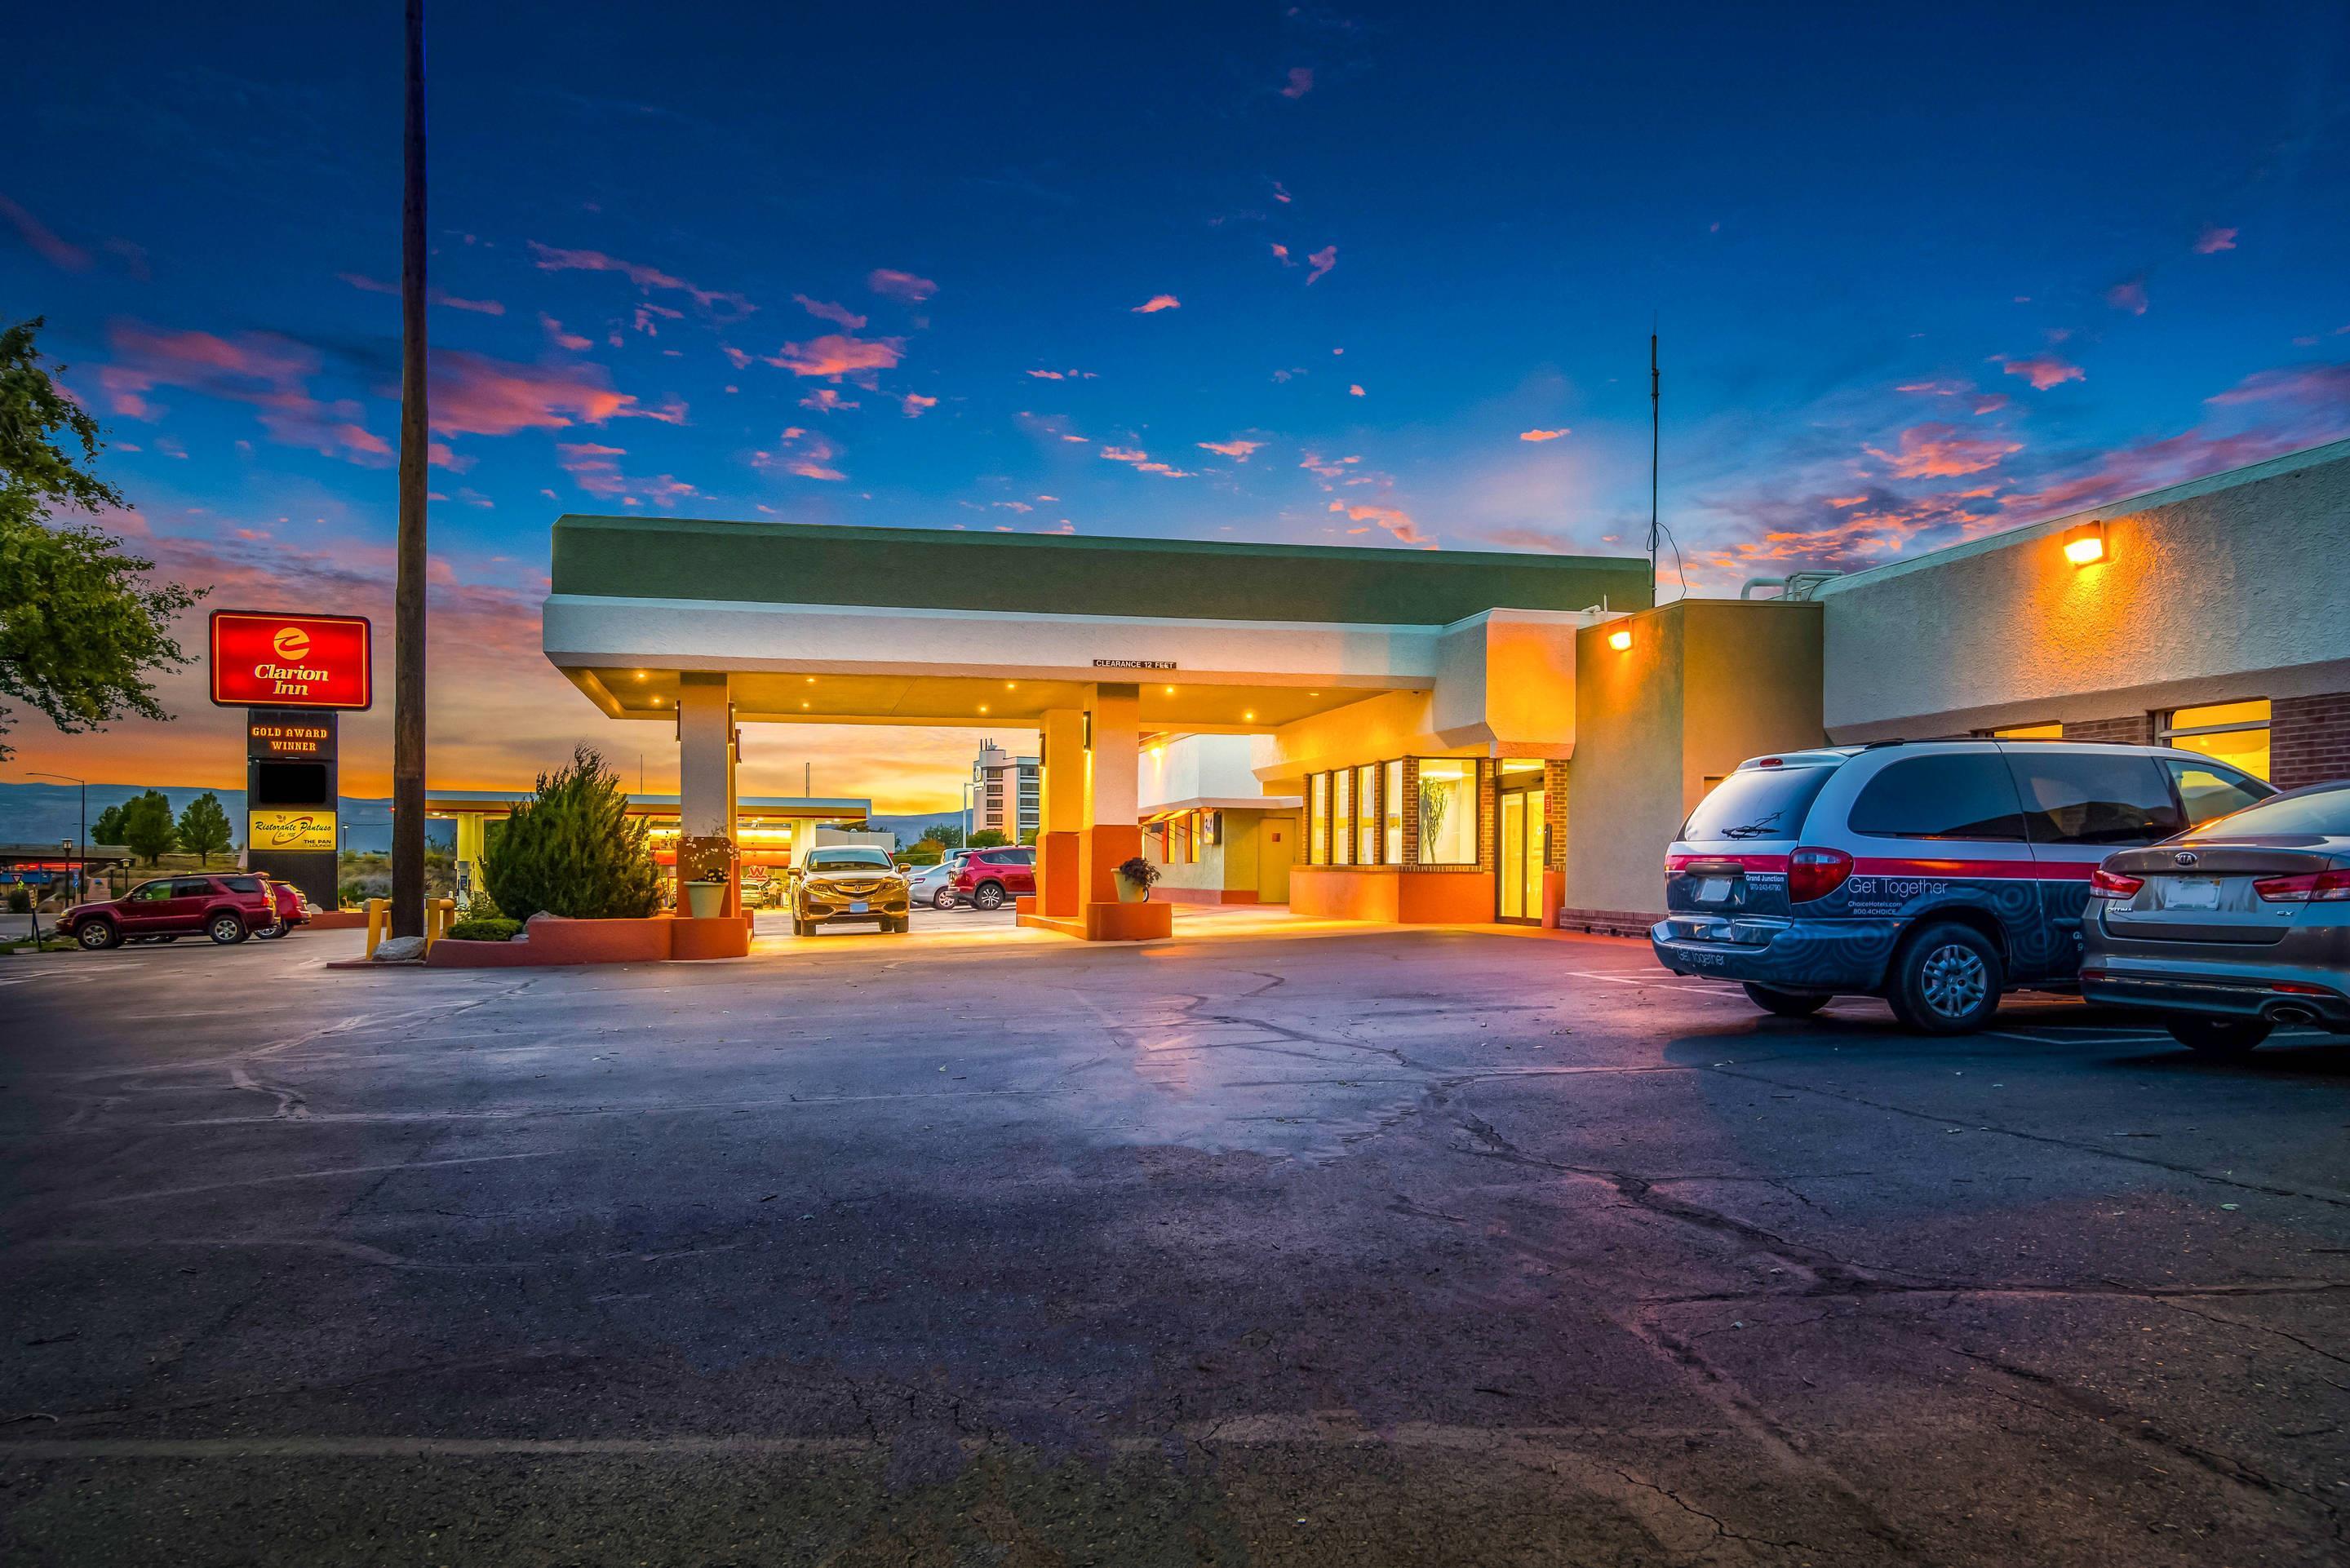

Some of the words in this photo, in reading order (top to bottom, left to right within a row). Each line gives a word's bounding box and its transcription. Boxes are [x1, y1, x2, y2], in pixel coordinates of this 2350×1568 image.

[255, 664, 329, 681] Clarion
[273, 680, 308, 695] Inn
[253, 727, 282, 737] GOLD
[286, 729, 327, 737] AWARD
[272, 741, 317, 751] WINNER
[255, 822, 296, 831] Ristorante
[299, 822, 331, 831] Pantuso
[2176, 855, 2193, 864] KIA
[1848, 877, 1877, 894] Get
[1881, 878, 1948, 897] Together
